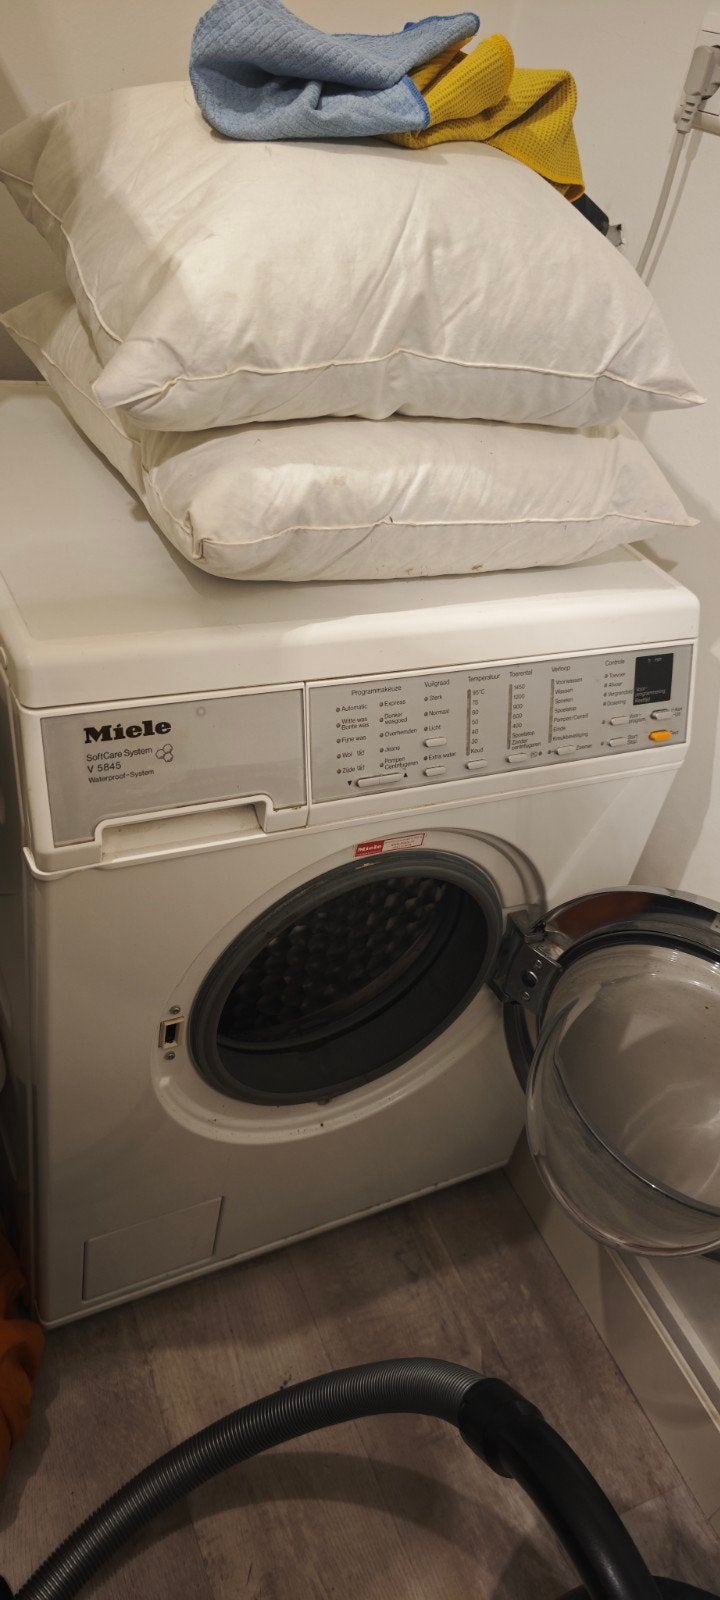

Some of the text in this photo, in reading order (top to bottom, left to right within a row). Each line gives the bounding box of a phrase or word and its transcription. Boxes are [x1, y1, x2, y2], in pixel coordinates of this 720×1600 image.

[509, 669, 533, 677] Toerental
[551, 665, 571, 673] Verloop
[468, 674, 500, 683] Temperatuur
[424, 679, 450, 688] Vuilgraad
[351, 686, 402, 696] Programmakeuze
[384, 699, 406, 707] Express
[83, 720, 172, 744] Miele
[384, 728, 417, 738] Overhemden
[86, 747, 153, 762] SoftCare System
[97, 762, 122, 772] 5845
[88, 769, 155, 784] Waterproof-System
[358, 844, 382, 852] Miele
